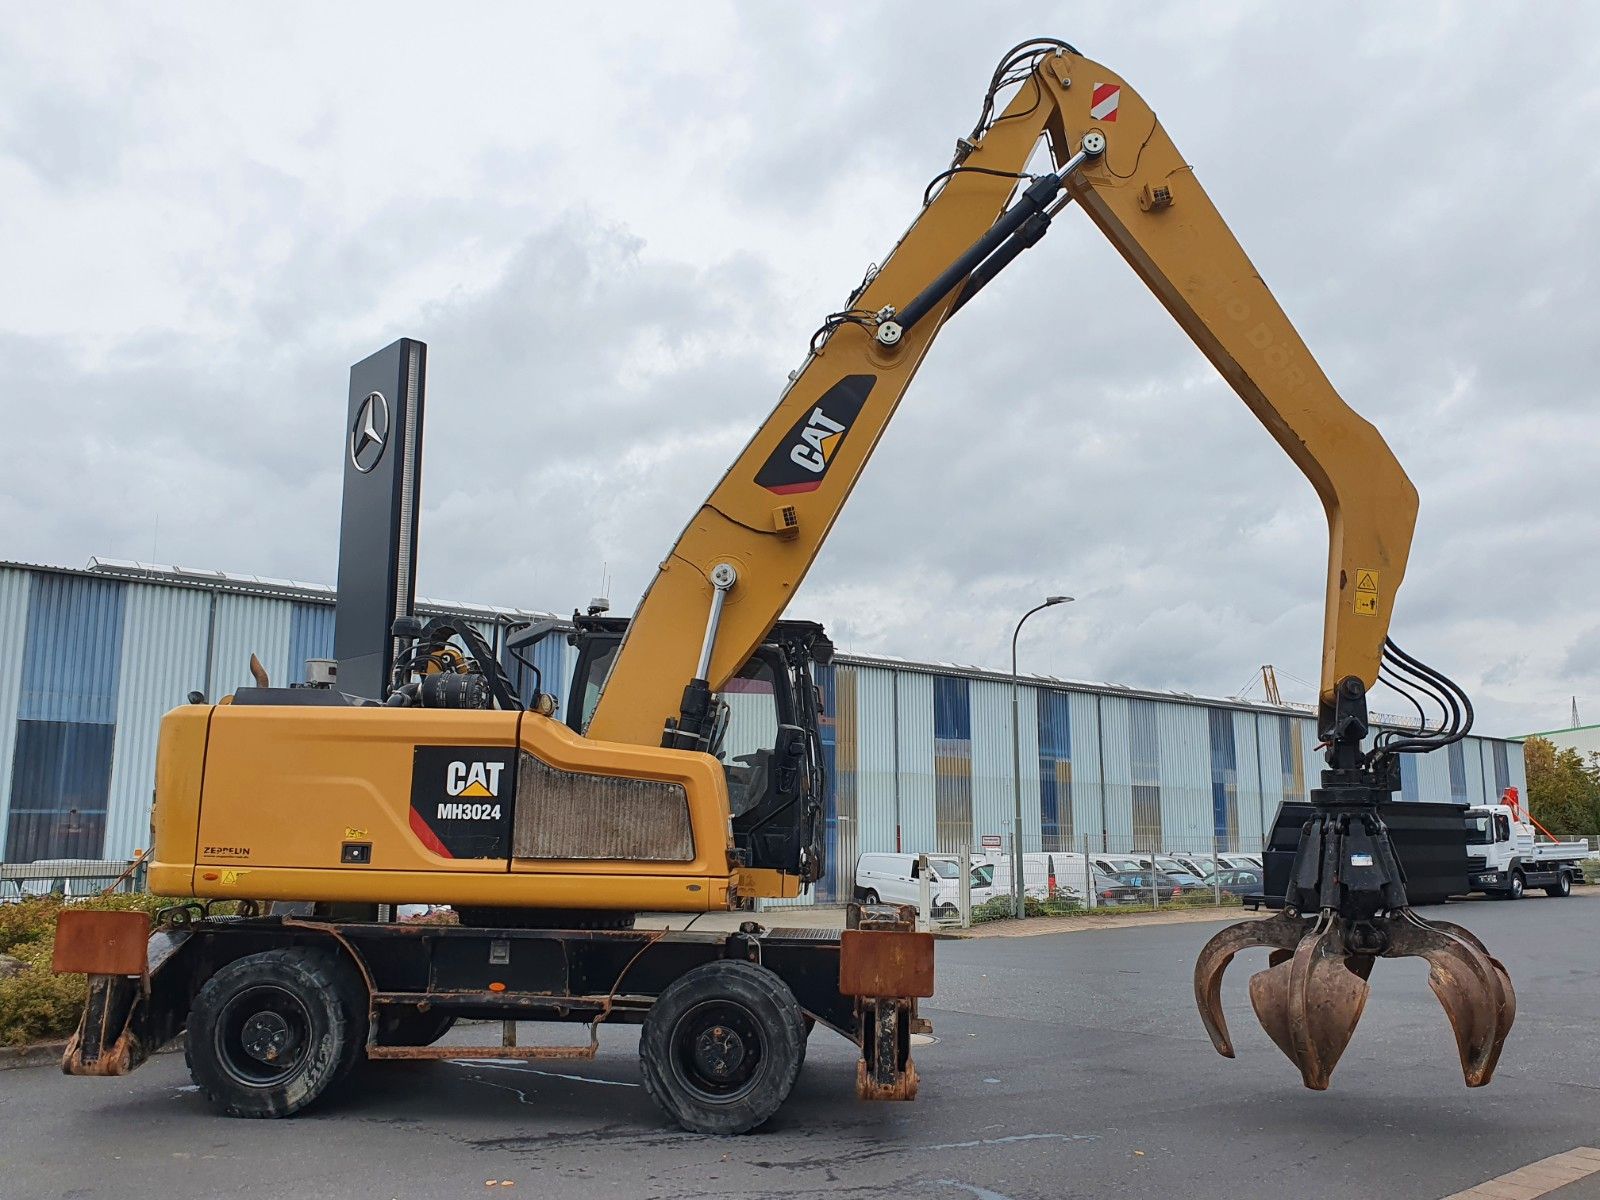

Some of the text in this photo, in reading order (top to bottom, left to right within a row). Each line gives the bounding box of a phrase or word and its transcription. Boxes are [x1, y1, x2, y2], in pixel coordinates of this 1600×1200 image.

[790, 407, 846, 473] CAT
[446, 761, 505, 797] CAT
[437, 803, 501, 820] MH3024
